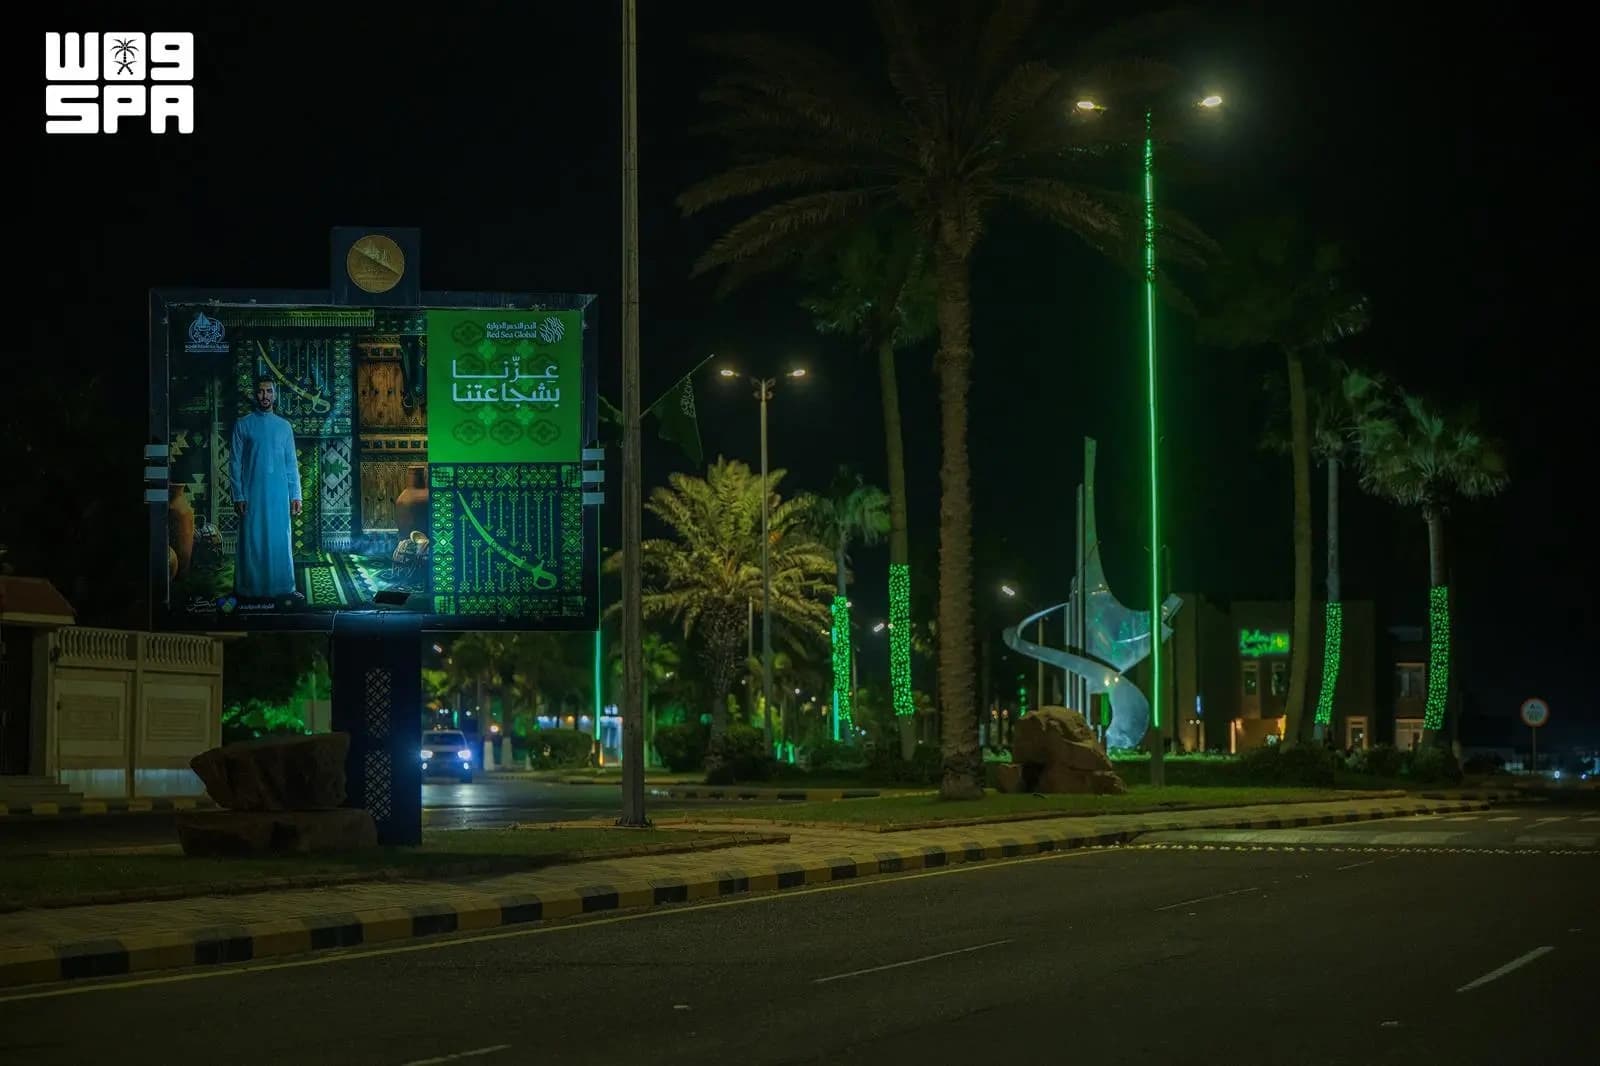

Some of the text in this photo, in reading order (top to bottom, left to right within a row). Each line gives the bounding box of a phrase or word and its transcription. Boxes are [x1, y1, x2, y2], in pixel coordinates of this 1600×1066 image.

[486, 330, 537, 338] Red Sea Global
[452, 382, 560, 408] بشجاعتنا
